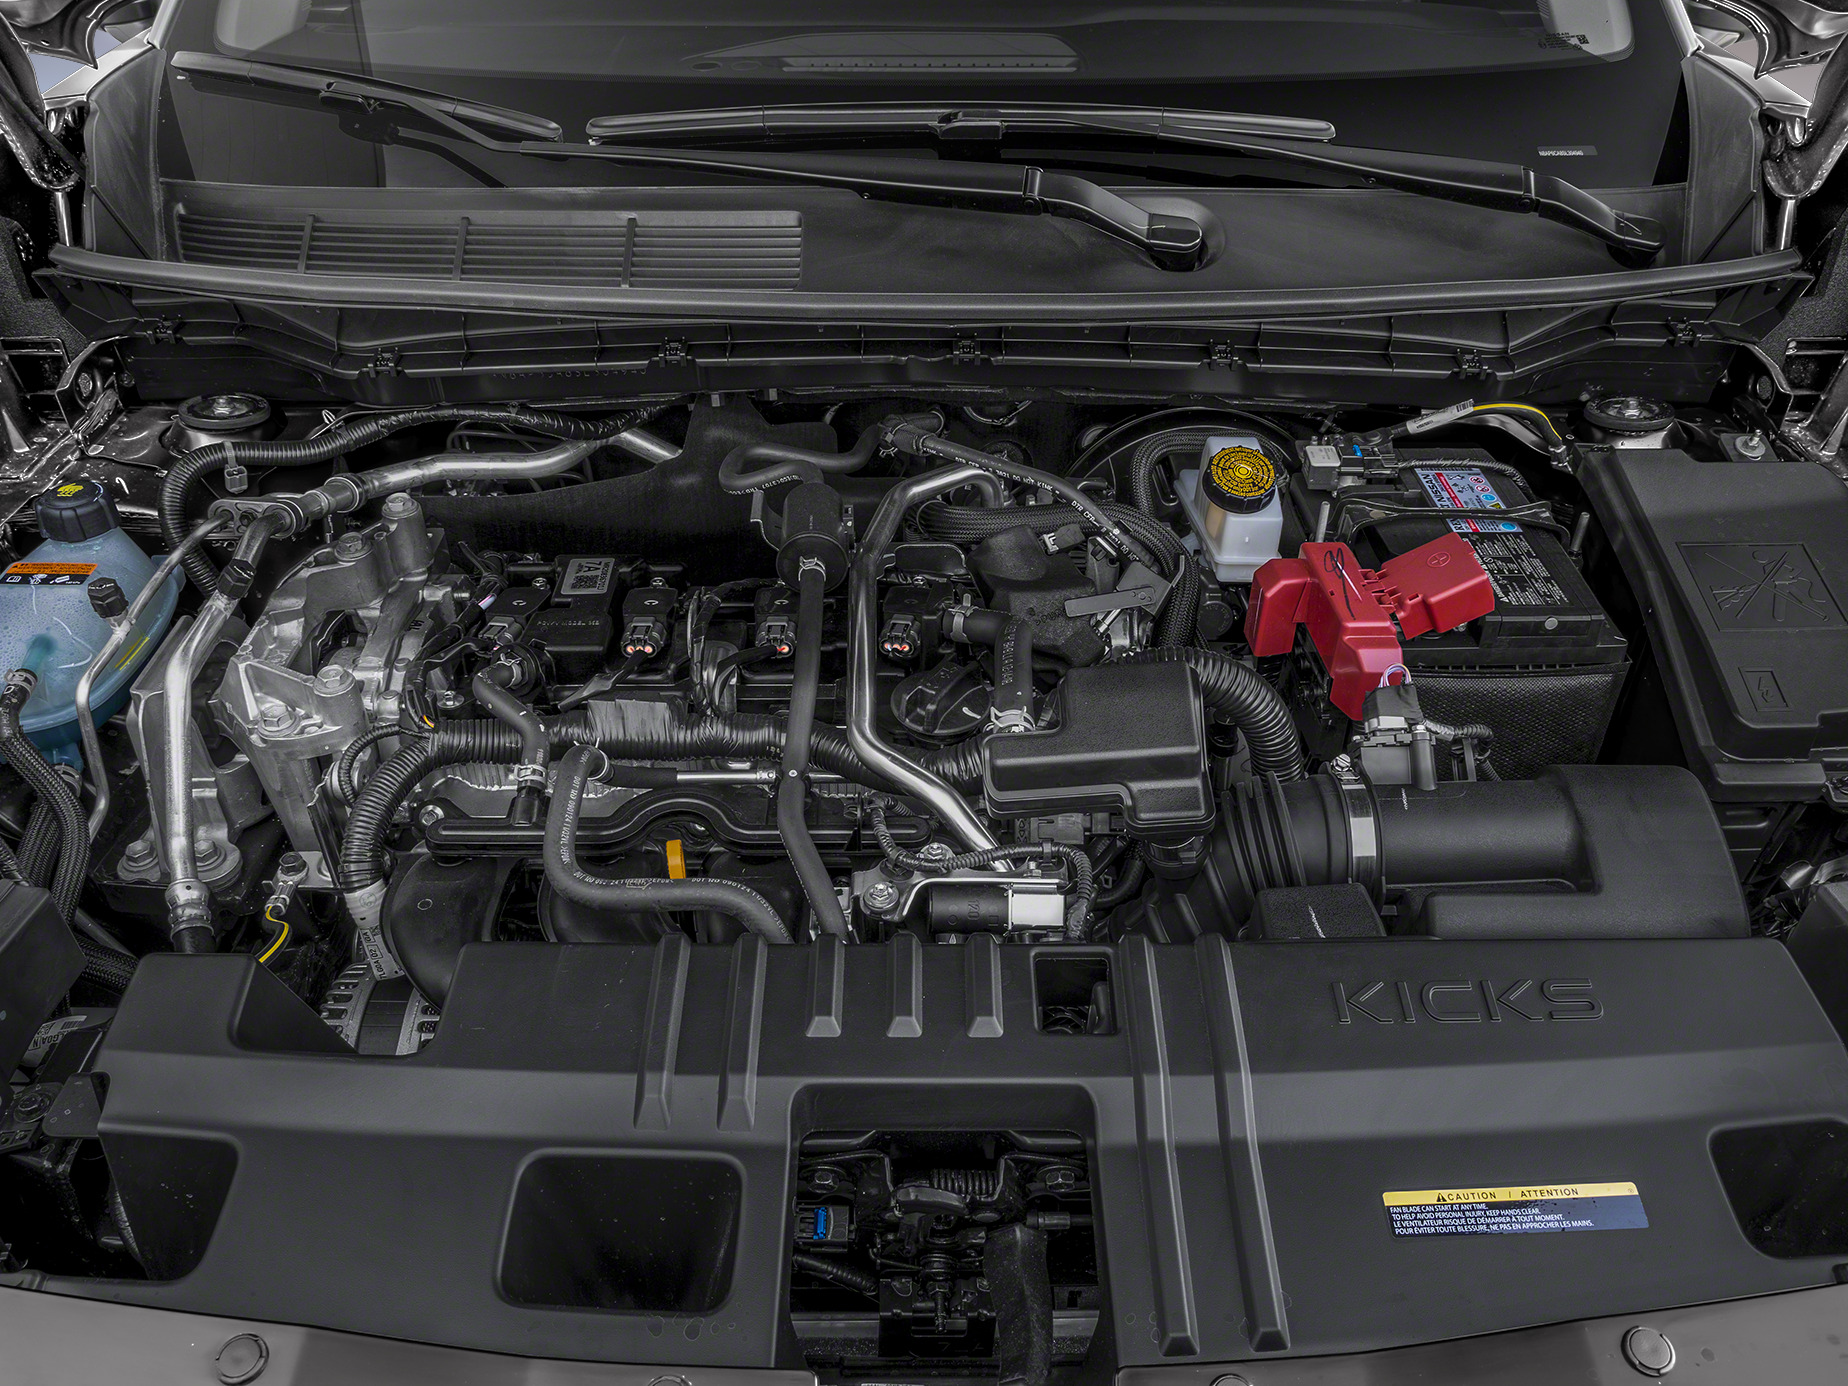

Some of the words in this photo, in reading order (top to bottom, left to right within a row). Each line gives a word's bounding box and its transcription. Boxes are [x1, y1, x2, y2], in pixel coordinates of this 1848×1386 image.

[1332, 978, 1604, 1024] KICKS
[1447, 1192, 1497, 1200] CAUTION
[1520, 1188, 1578, 1198] ATTENTION
[1401, 1220, 1443, 1228] VENTILATEUR
[1415, 1226, 1436, 1234] ÉVITER
